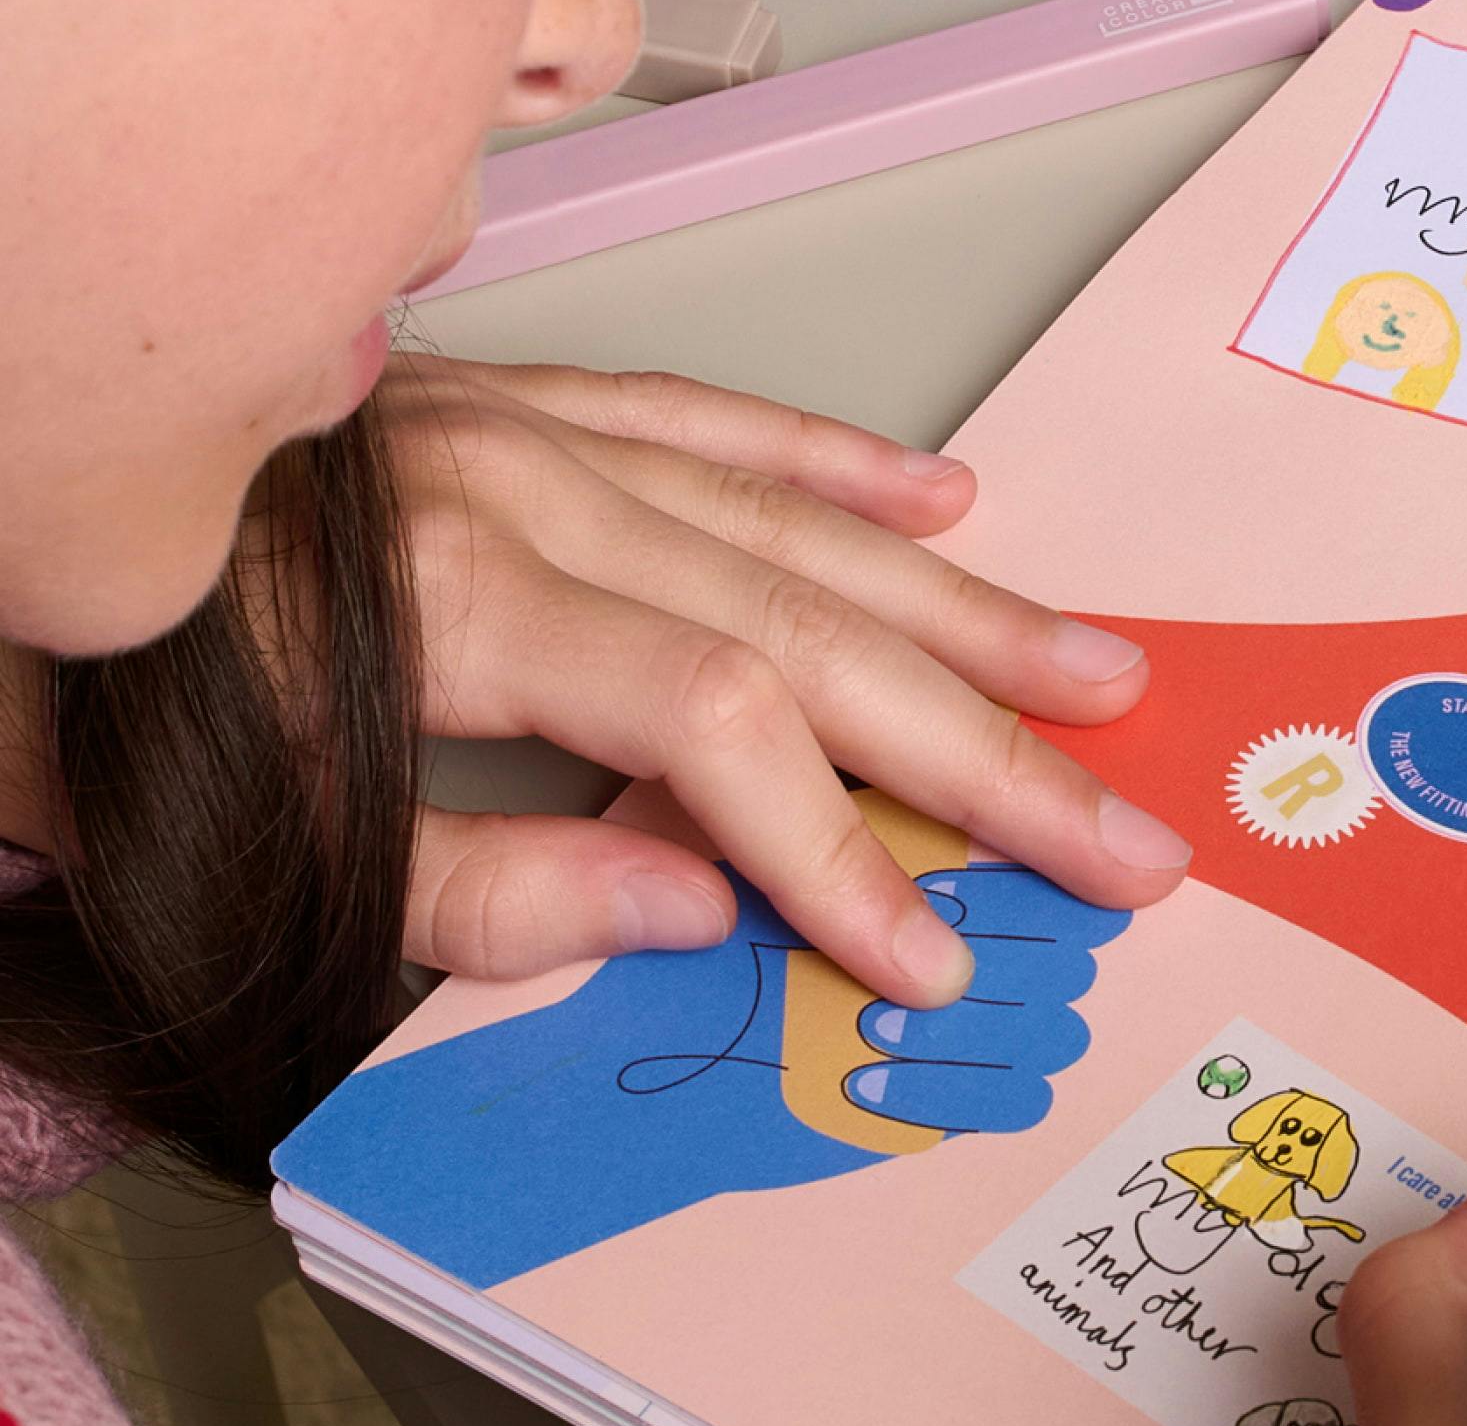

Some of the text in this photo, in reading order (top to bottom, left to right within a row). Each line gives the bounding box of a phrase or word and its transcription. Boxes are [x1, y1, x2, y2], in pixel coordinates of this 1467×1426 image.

[1109, 0, 1186, 28] COLOR
[1390, 730, 1413, 759] THE
[1260, 751, 1345, 821] R
[1393, 759, 1428, 792] NEW
[1386, 1154, 1442, 1200] I care
[1060, 1223, 1258, 1361] And other
[1018, 1263, 1137, 1372] animals
